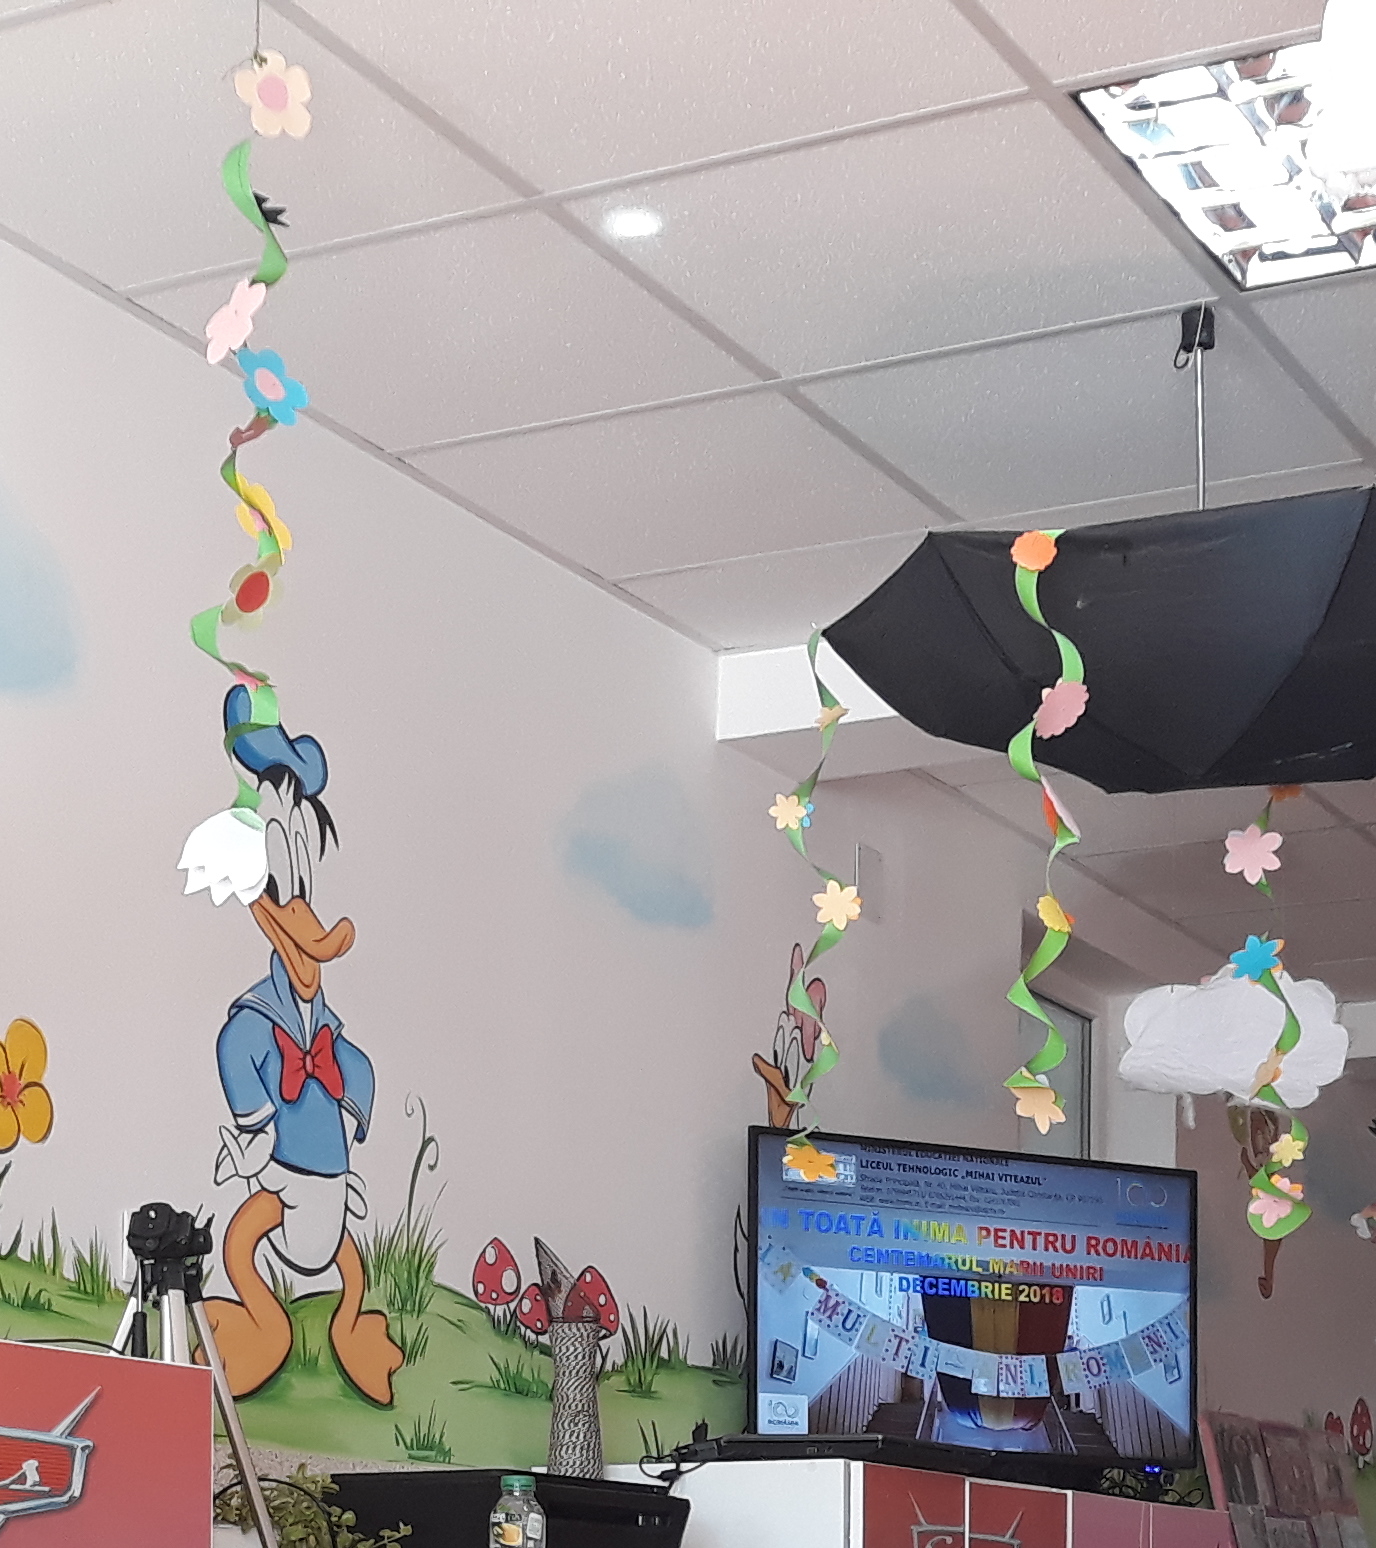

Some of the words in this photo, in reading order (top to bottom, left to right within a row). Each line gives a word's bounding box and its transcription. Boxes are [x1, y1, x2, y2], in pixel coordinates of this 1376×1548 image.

[859, 1159, 894, 1172] LICEUL
[896, 1163, 959, 1178] TEHNOLOGIC
[798, 1209, 884, 1238] TOATĂ
[893, 1218, 968, 1245] INIMA
[977, 1225, 1077, 1255] PENTRU
[848, 1245, 983, 1273] CENTENARUL
[1051, 1262, 1105, 1282] UNIRI
[898, 1276, 1013, 1301] DECEMBRIE
[1017, 1284, 1064, 1304] 2018
